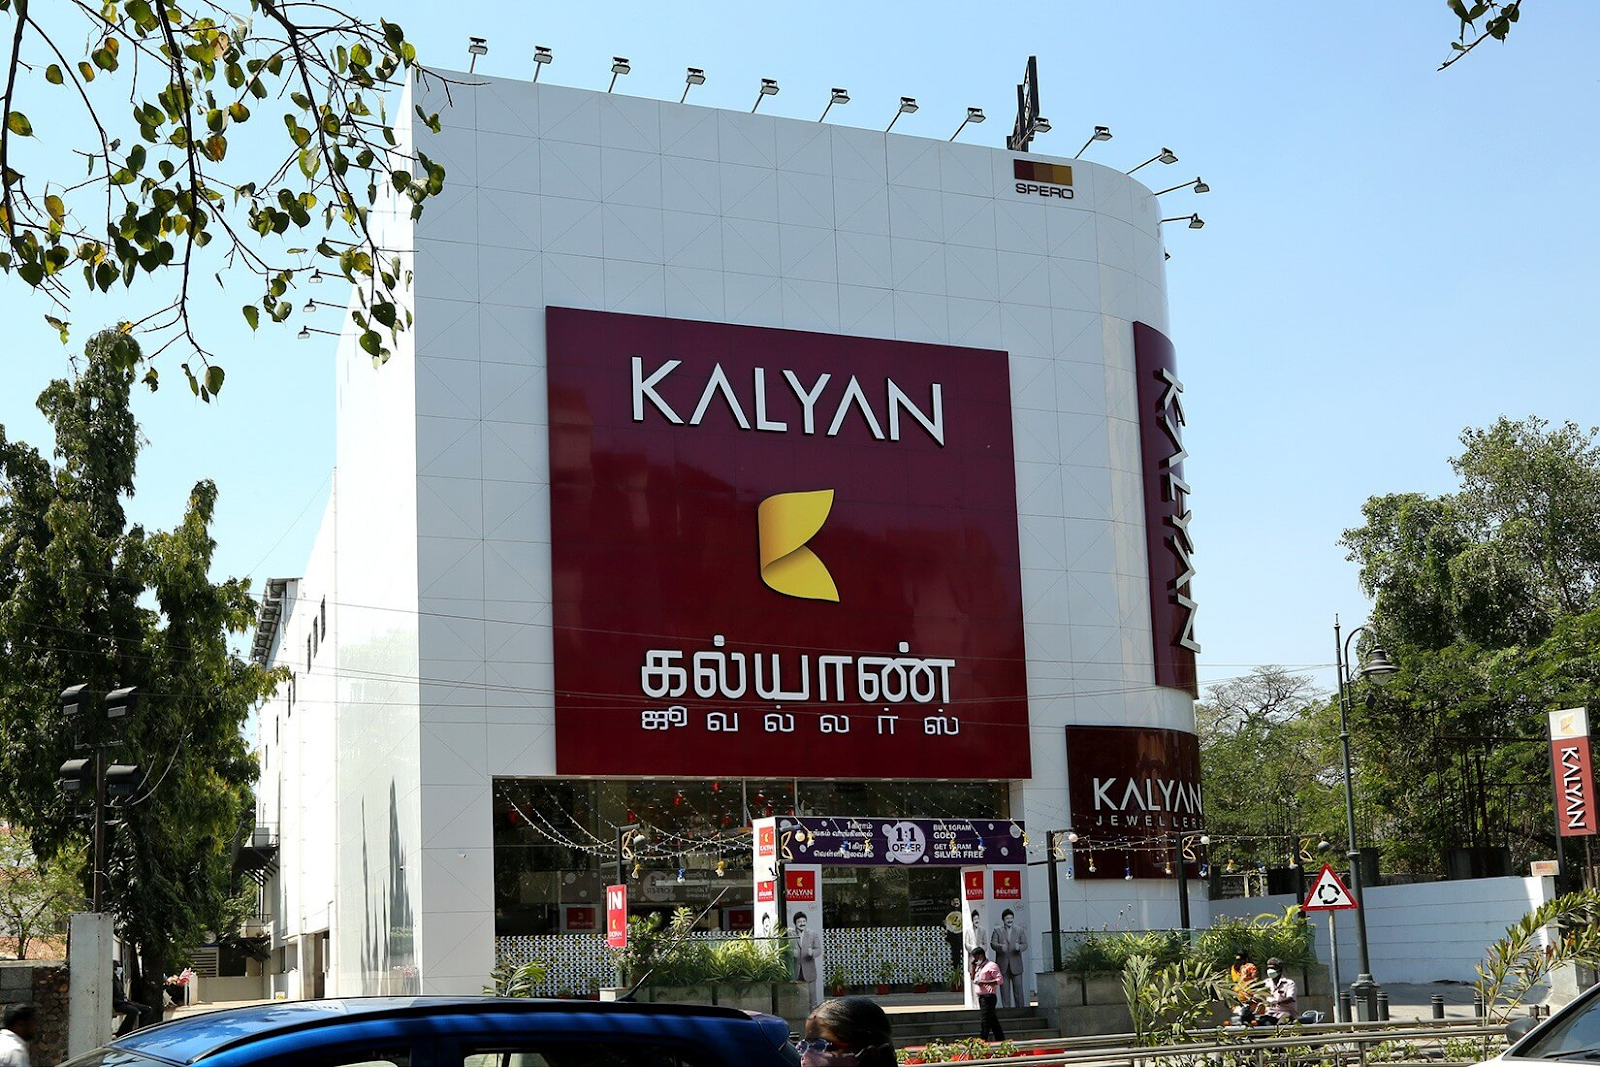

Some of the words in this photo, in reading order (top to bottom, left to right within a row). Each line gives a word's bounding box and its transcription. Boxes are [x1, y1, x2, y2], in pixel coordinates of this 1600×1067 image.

[1015, 183, 1074, 199] SPERO
[631, 356, 945, 446] KALYAN
[1162, 367, 1201, 654] KALYAN
[641, 634, 955, 704] கல்யாண்
[1093, 777, 1203, 815] KALYAN
[1560, 747, 1587, 828] KALYAN
[896, 827, 917, 841] 1:1
[1095, 815, 1203, 830] JEWELLERS
[934, 851, 961, 859] SILVER
[963, 851, 984, 859] FREE
[608, 890, 623, 911] IN
